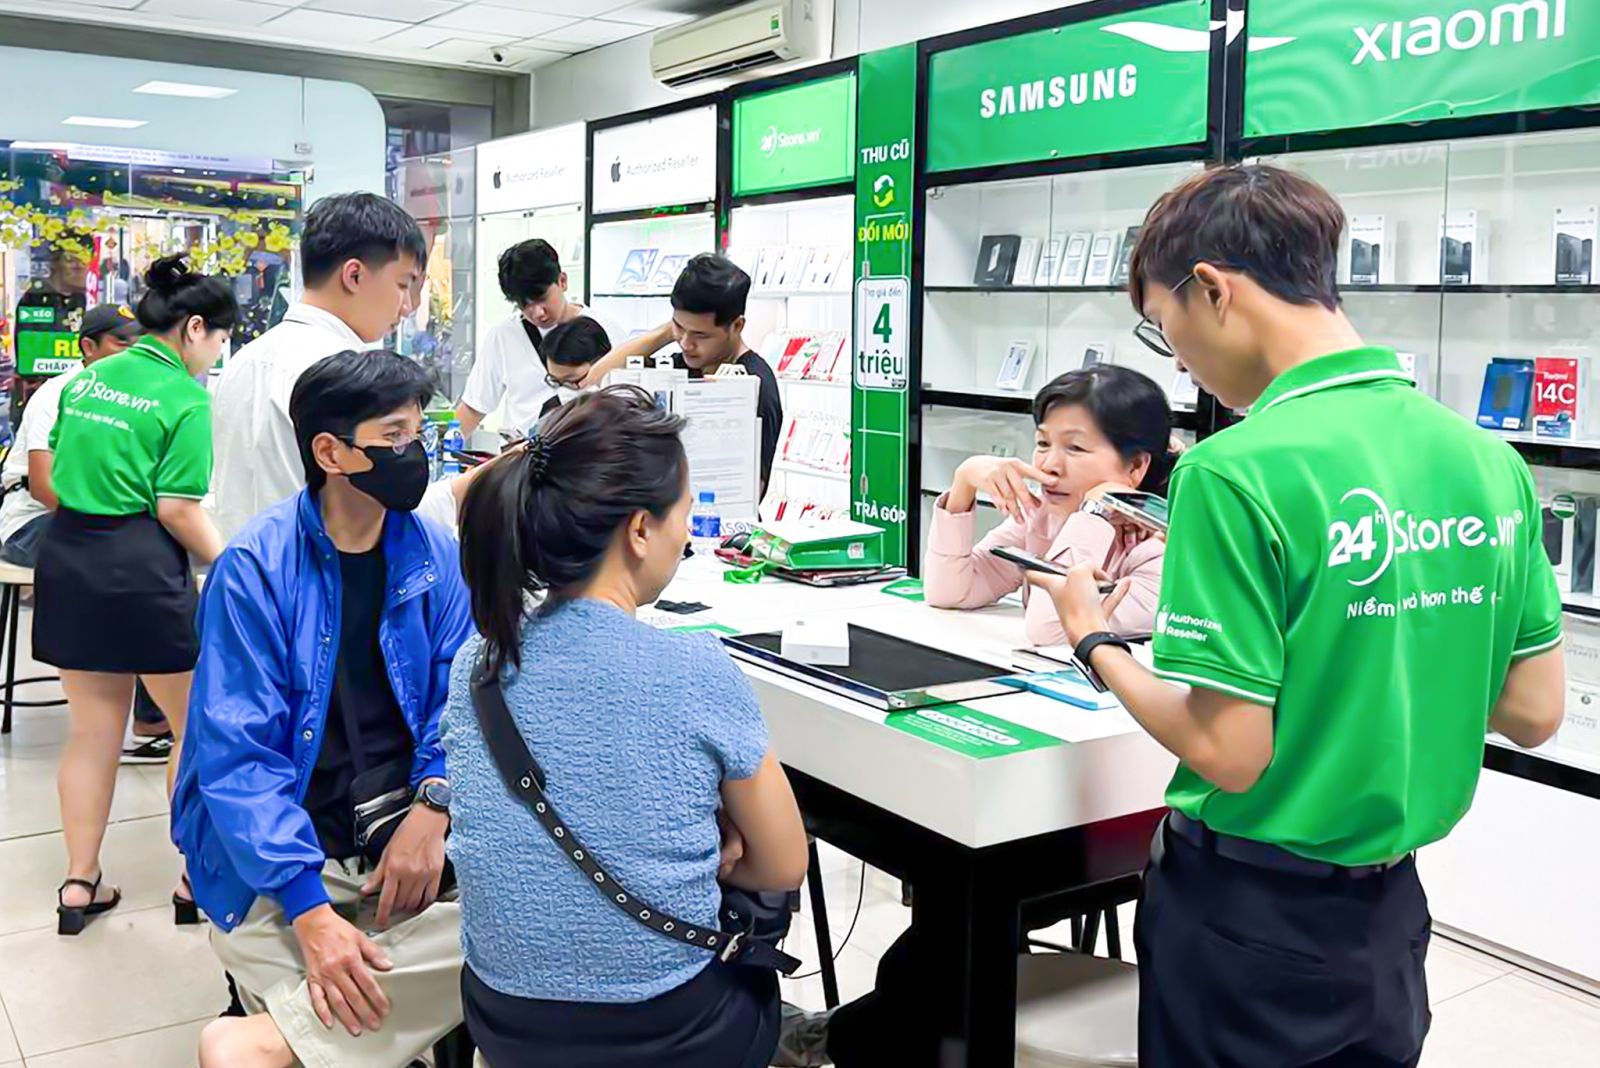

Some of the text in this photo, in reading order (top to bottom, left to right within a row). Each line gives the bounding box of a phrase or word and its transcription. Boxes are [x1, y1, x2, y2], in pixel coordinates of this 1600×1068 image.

[980, 63, 1137, 118] SAMSUNG
[861, 138, 909, 164] THU CŨ
[873, 303, 892, 343] 4
[859, 349, 903, 380] triệu
[1536, 382, 1575, 404] 14C
[854, 500, 906, 523] TRÀ GÓP
[1403, 592, 1418, 610] và
[1452, 585, 1485, 604] thế
